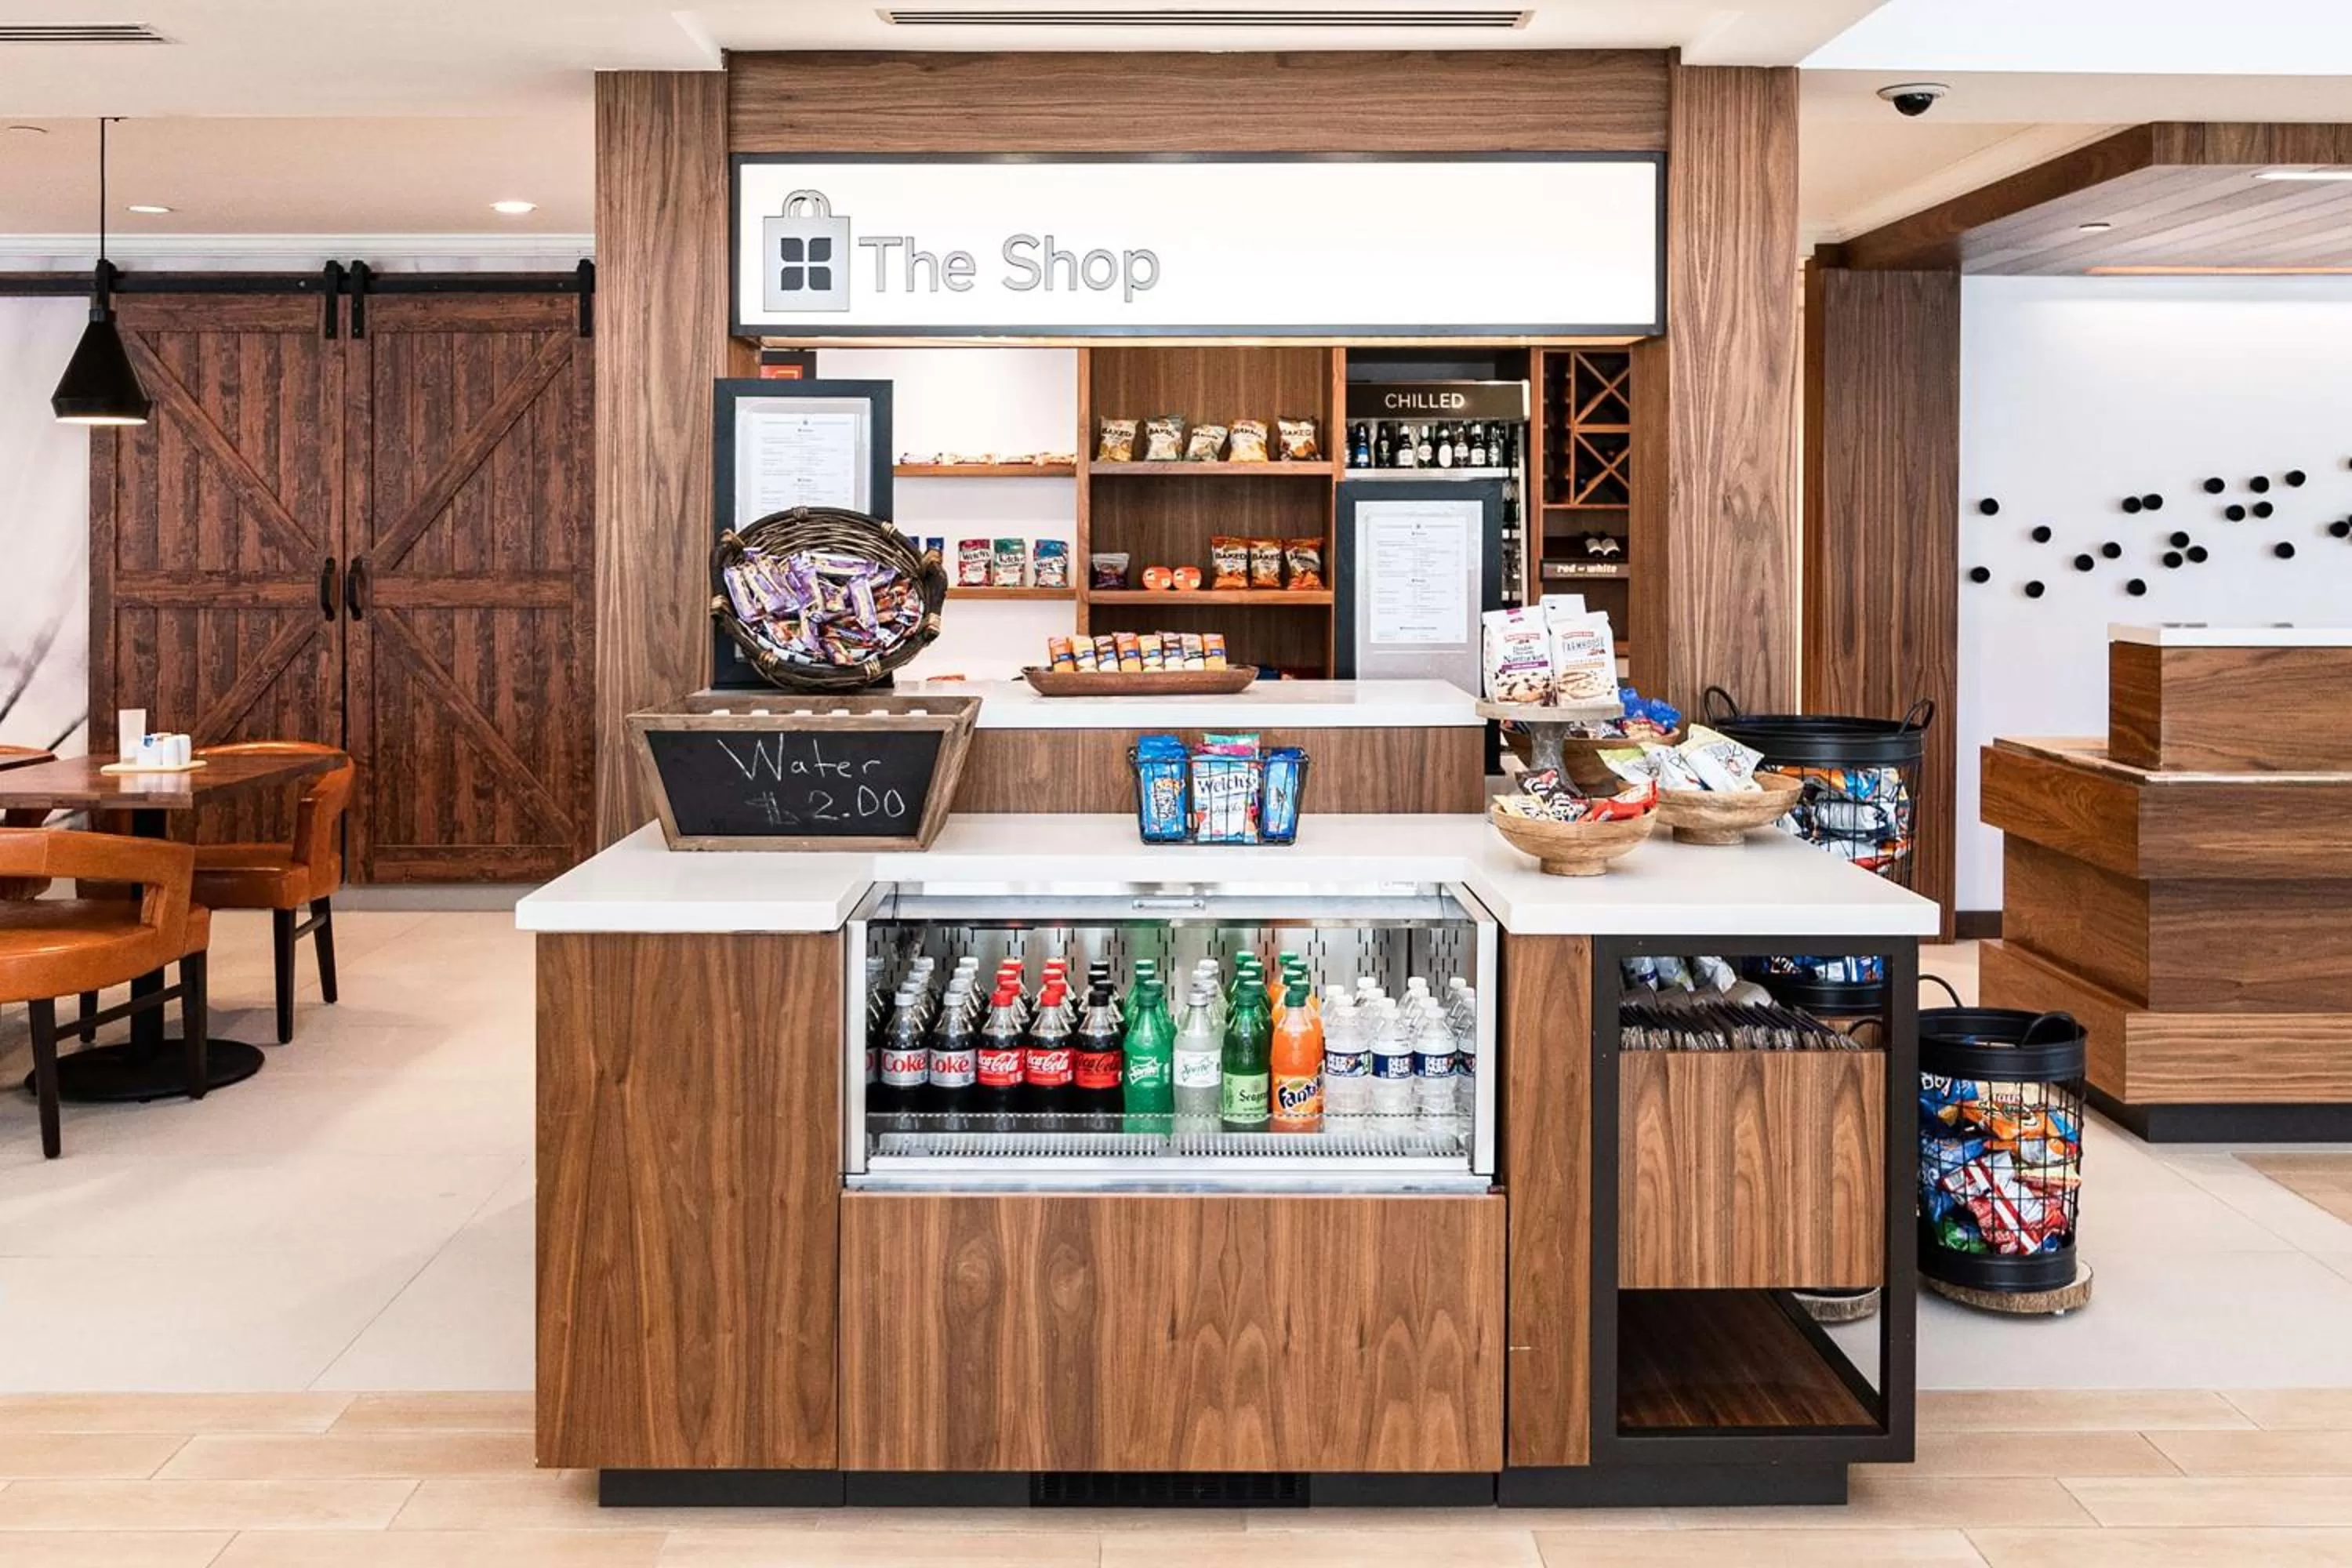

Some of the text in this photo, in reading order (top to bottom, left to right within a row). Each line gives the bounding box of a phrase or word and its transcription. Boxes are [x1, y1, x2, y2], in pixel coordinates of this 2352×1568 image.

[858, 233, 1160, 303] The Shop
[1385, 393, 1465, 408] CHILLED
[1586, 564, 1617, 573] white
[717, 731, 882, 782] Water
[883, 1052, 927, 1073] Coke
